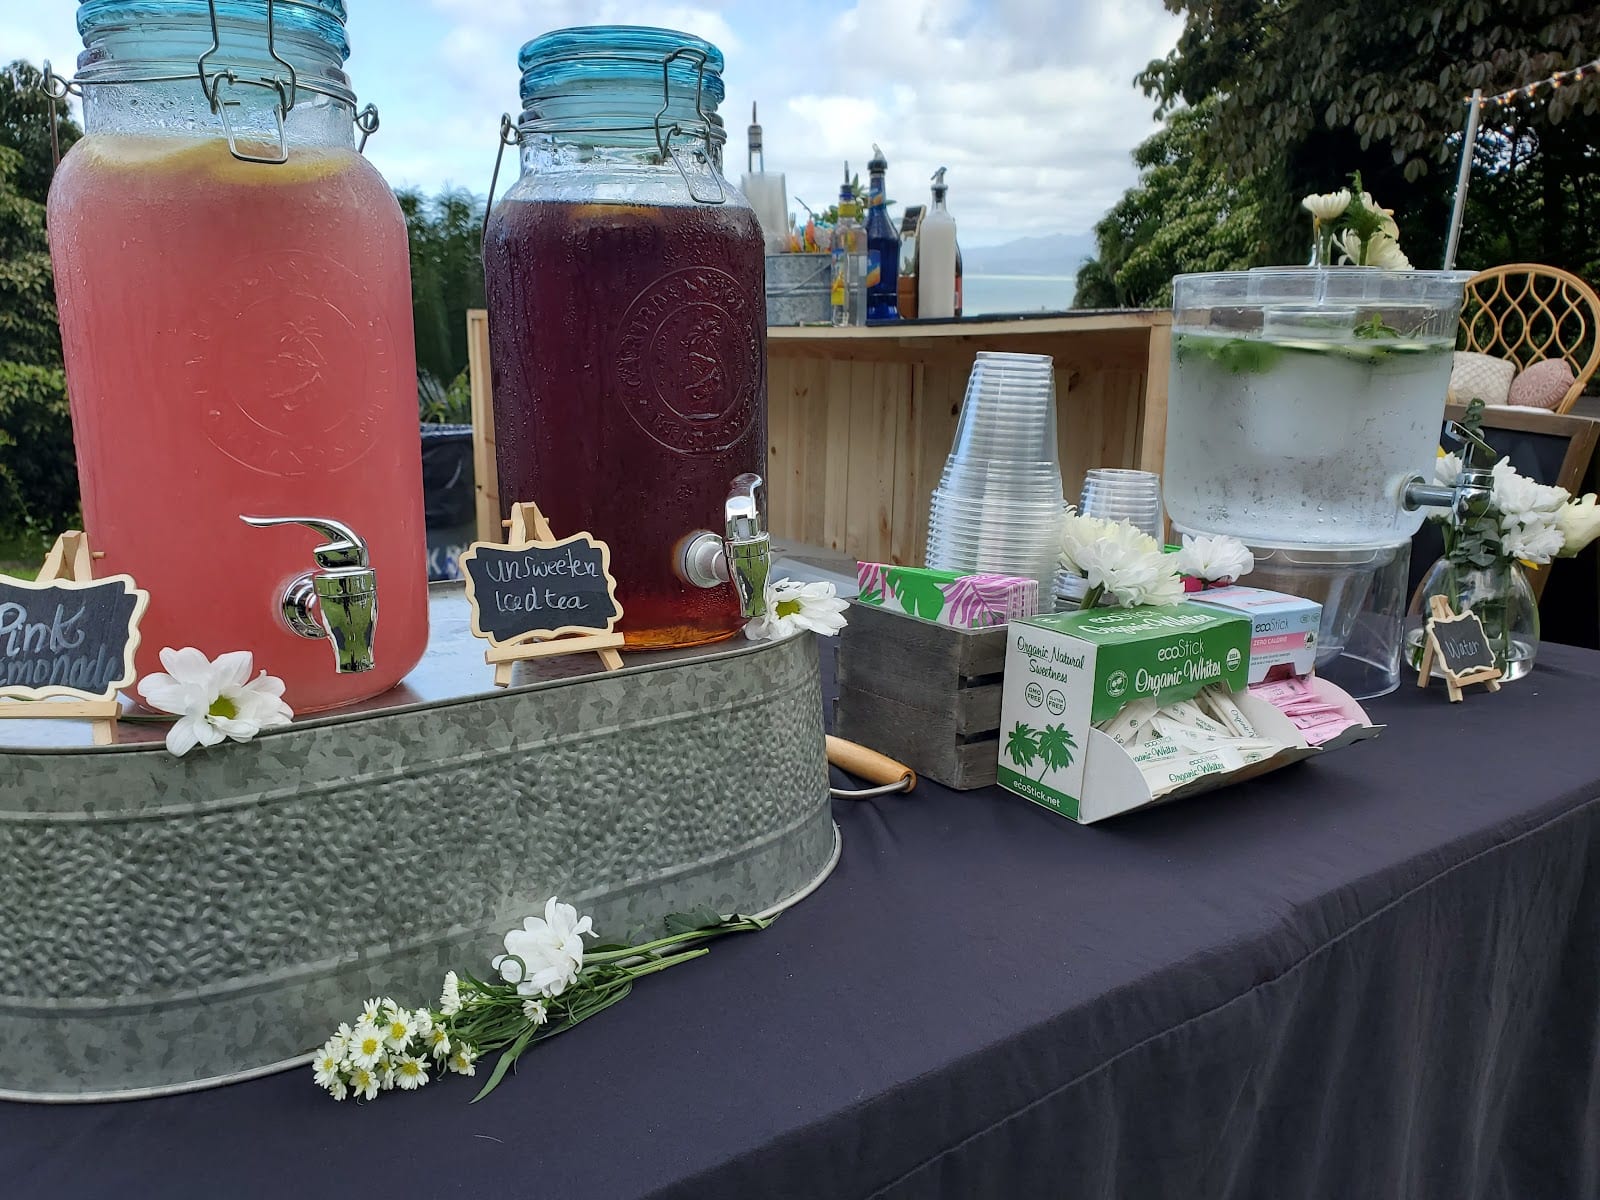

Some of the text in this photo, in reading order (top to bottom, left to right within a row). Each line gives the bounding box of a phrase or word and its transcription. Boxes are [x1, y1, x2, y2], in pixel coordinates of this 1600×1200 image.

[544, 588, 589, 610] tea
[0, 601, 86, 657] Pink
[1255, 618, 1289, 632] ecoStick
[1017, 635, 1085, 670] Organic Natural
[1157, 638, 1205, 661] ecoStick
[1445, 637, 1480, 659] Water
[1028, 658, 1068, 684] Sweetness
[1135, 656, 1221, 697] Organic Whites
[1027, 693, 1042, 703] FREE
[1028, 686, 1042, 696] GMO
[1048, 700, 1064, 710] FREE
[1168, 769, 1198, 783] Organic
[1013, 779, 1061, 808] ecoStick.net
